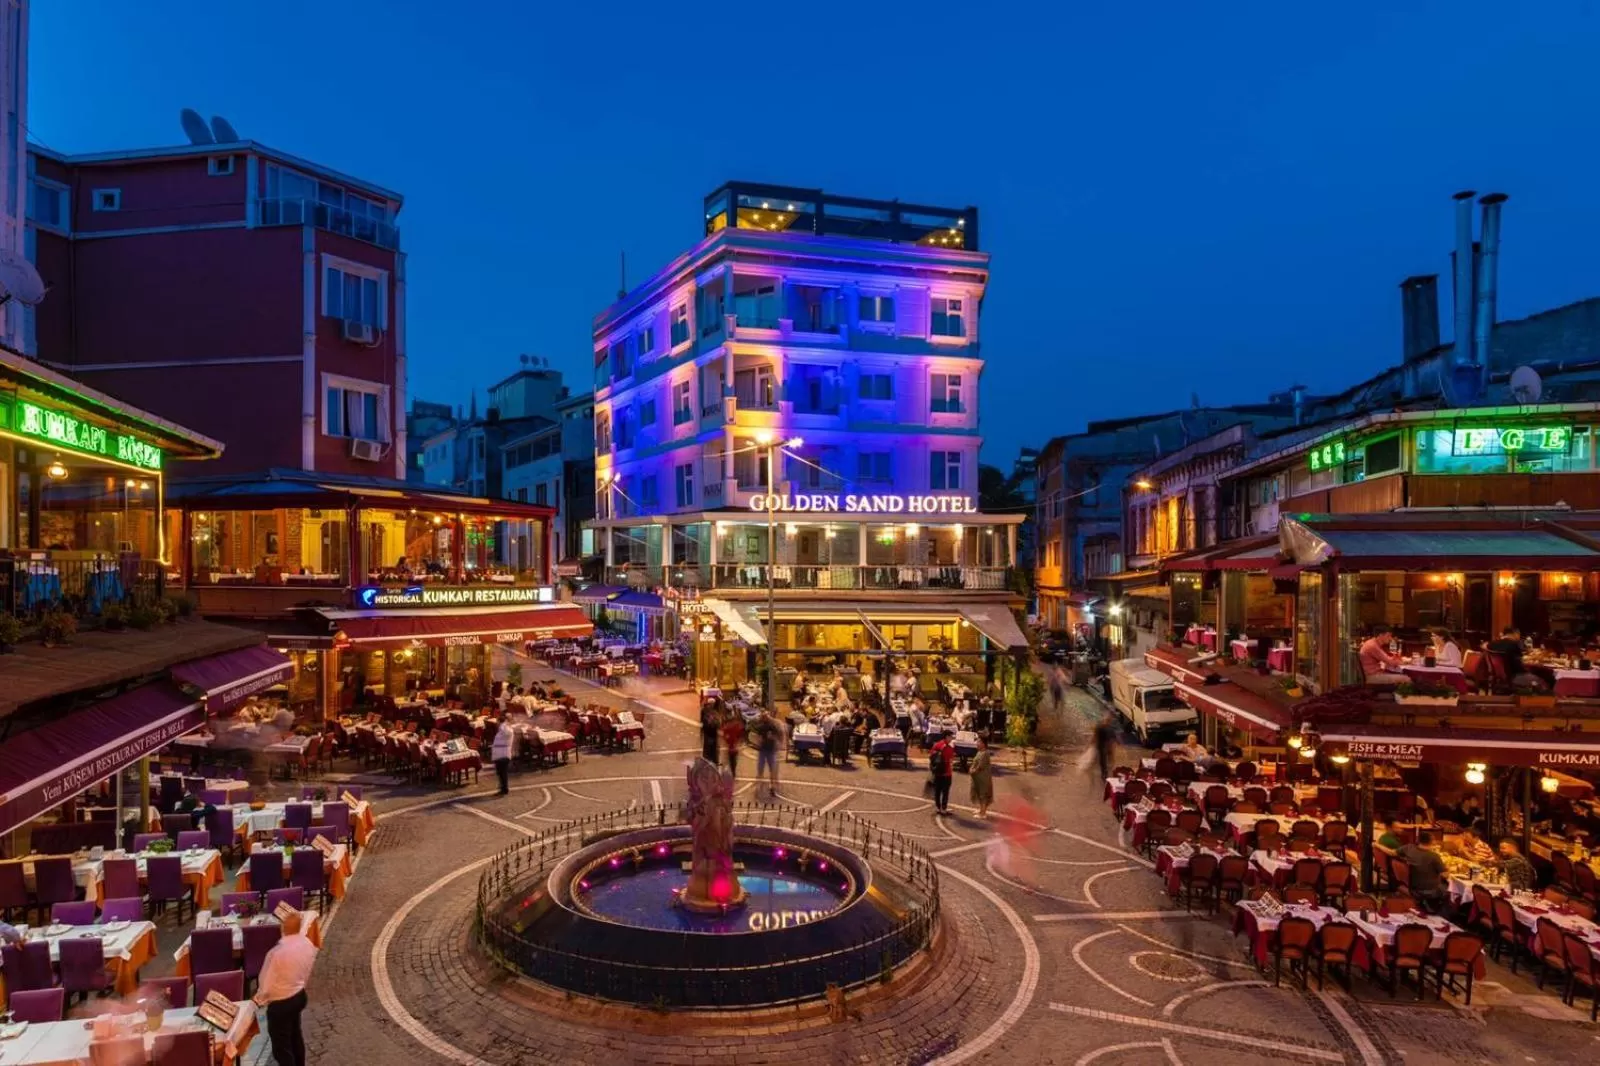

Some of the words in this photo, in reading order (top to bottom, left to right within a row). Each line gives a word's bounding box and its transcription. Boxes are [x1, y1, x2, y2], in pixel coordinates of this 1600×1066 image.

[21, 403, 106, 454] KUMKAPI
[1463, 428, 1565, 449] EGE
[750, 495, 838, 511] GOLDEN
[845, 495, 904, 512] SAND
[908, 496, 977, 512] HOTEL
[375, 594, 421, 604] HISTORICAL
[423, 591, 474, 603] KUMKAPI
[475, 589, 539, 602] RESTAURANT
[444, 635, 482, 646] HISTORICAL
[496, 632, 524, 643] KUMKAPI
[1347, 742, 1374, 752] FISH
[1376, 745, 1386, 753] &
[1389, 744, 1424, 755] MEAT
[42, 780, 62, 802] Yeni
[96, 739, 145, 774] RESTAURANT
[145, 729, 162, 748] FISH
[167, 719, 186, 737] MEAT
[1539, 753, 1599, 765] KUMKAPI
